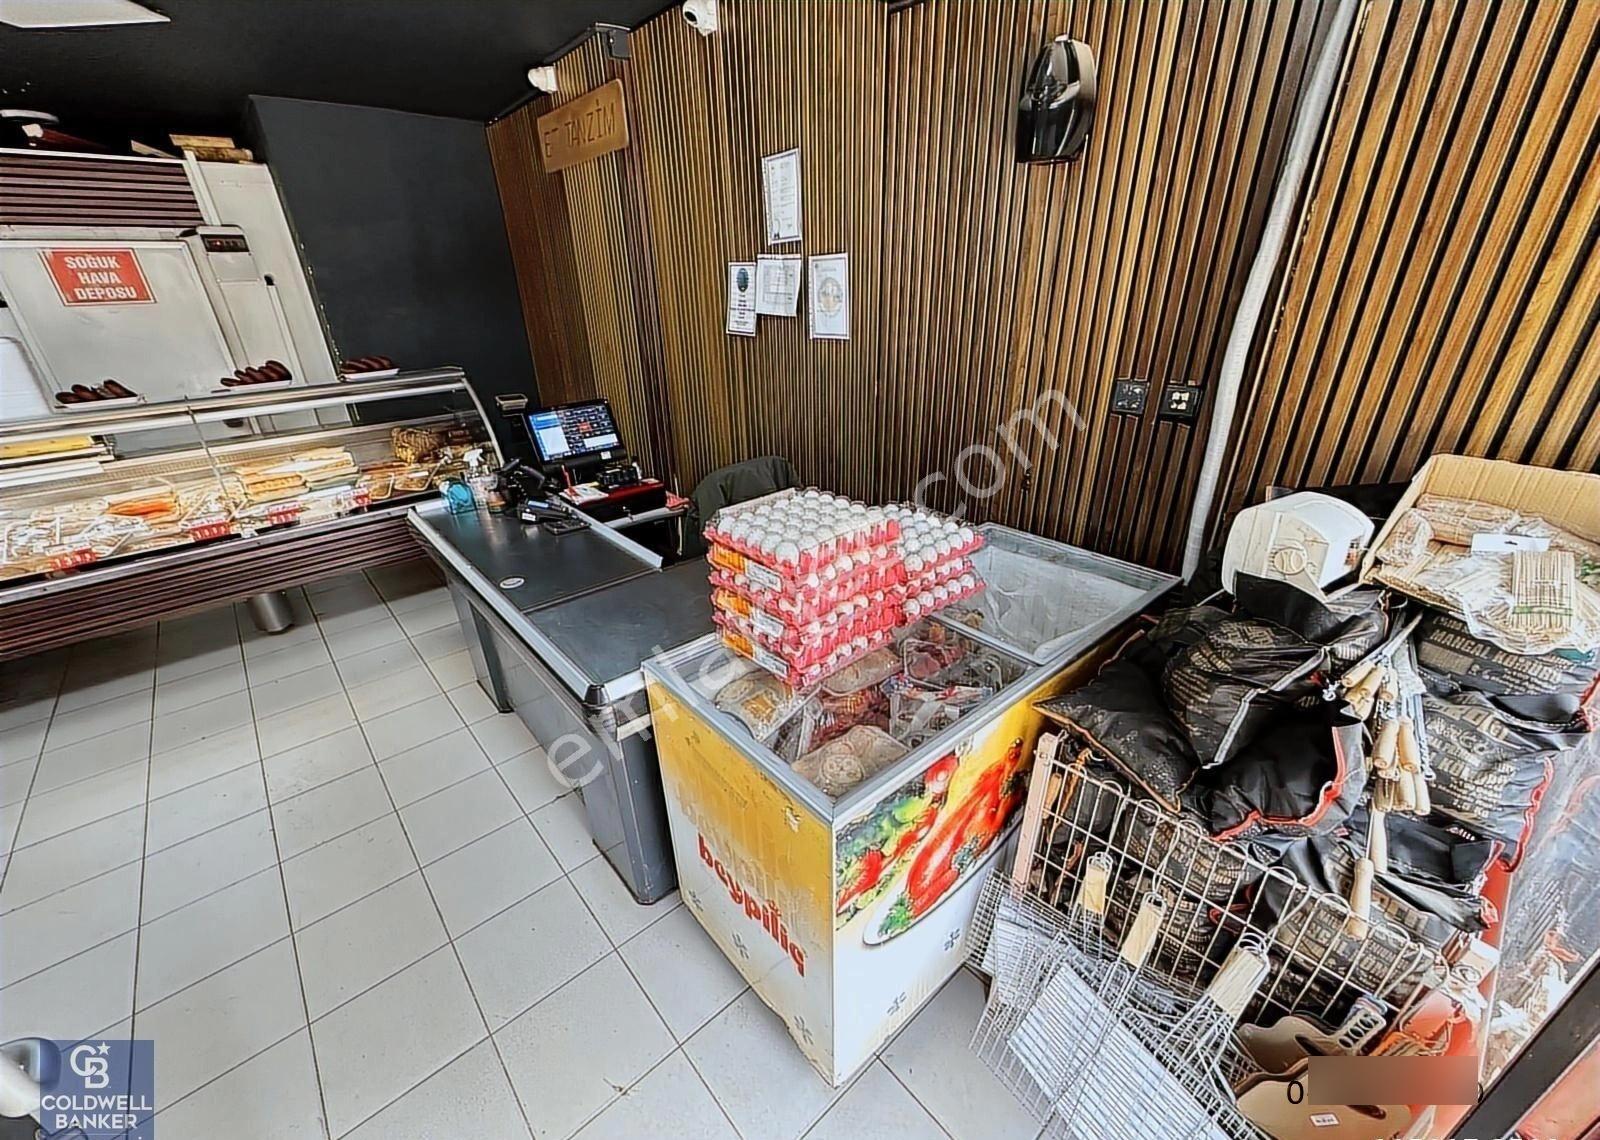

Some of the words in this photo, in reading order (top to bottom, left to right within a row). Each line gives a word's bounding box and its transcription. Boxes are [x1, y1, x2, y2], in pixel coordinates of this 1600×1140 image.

[564, 98, 615, 148] TANZİM
[64, 254, 121, 269] SOĞUK
[78, 271, 122, 285] HAVA
[74, 286, 137, 300] DEPOSU
